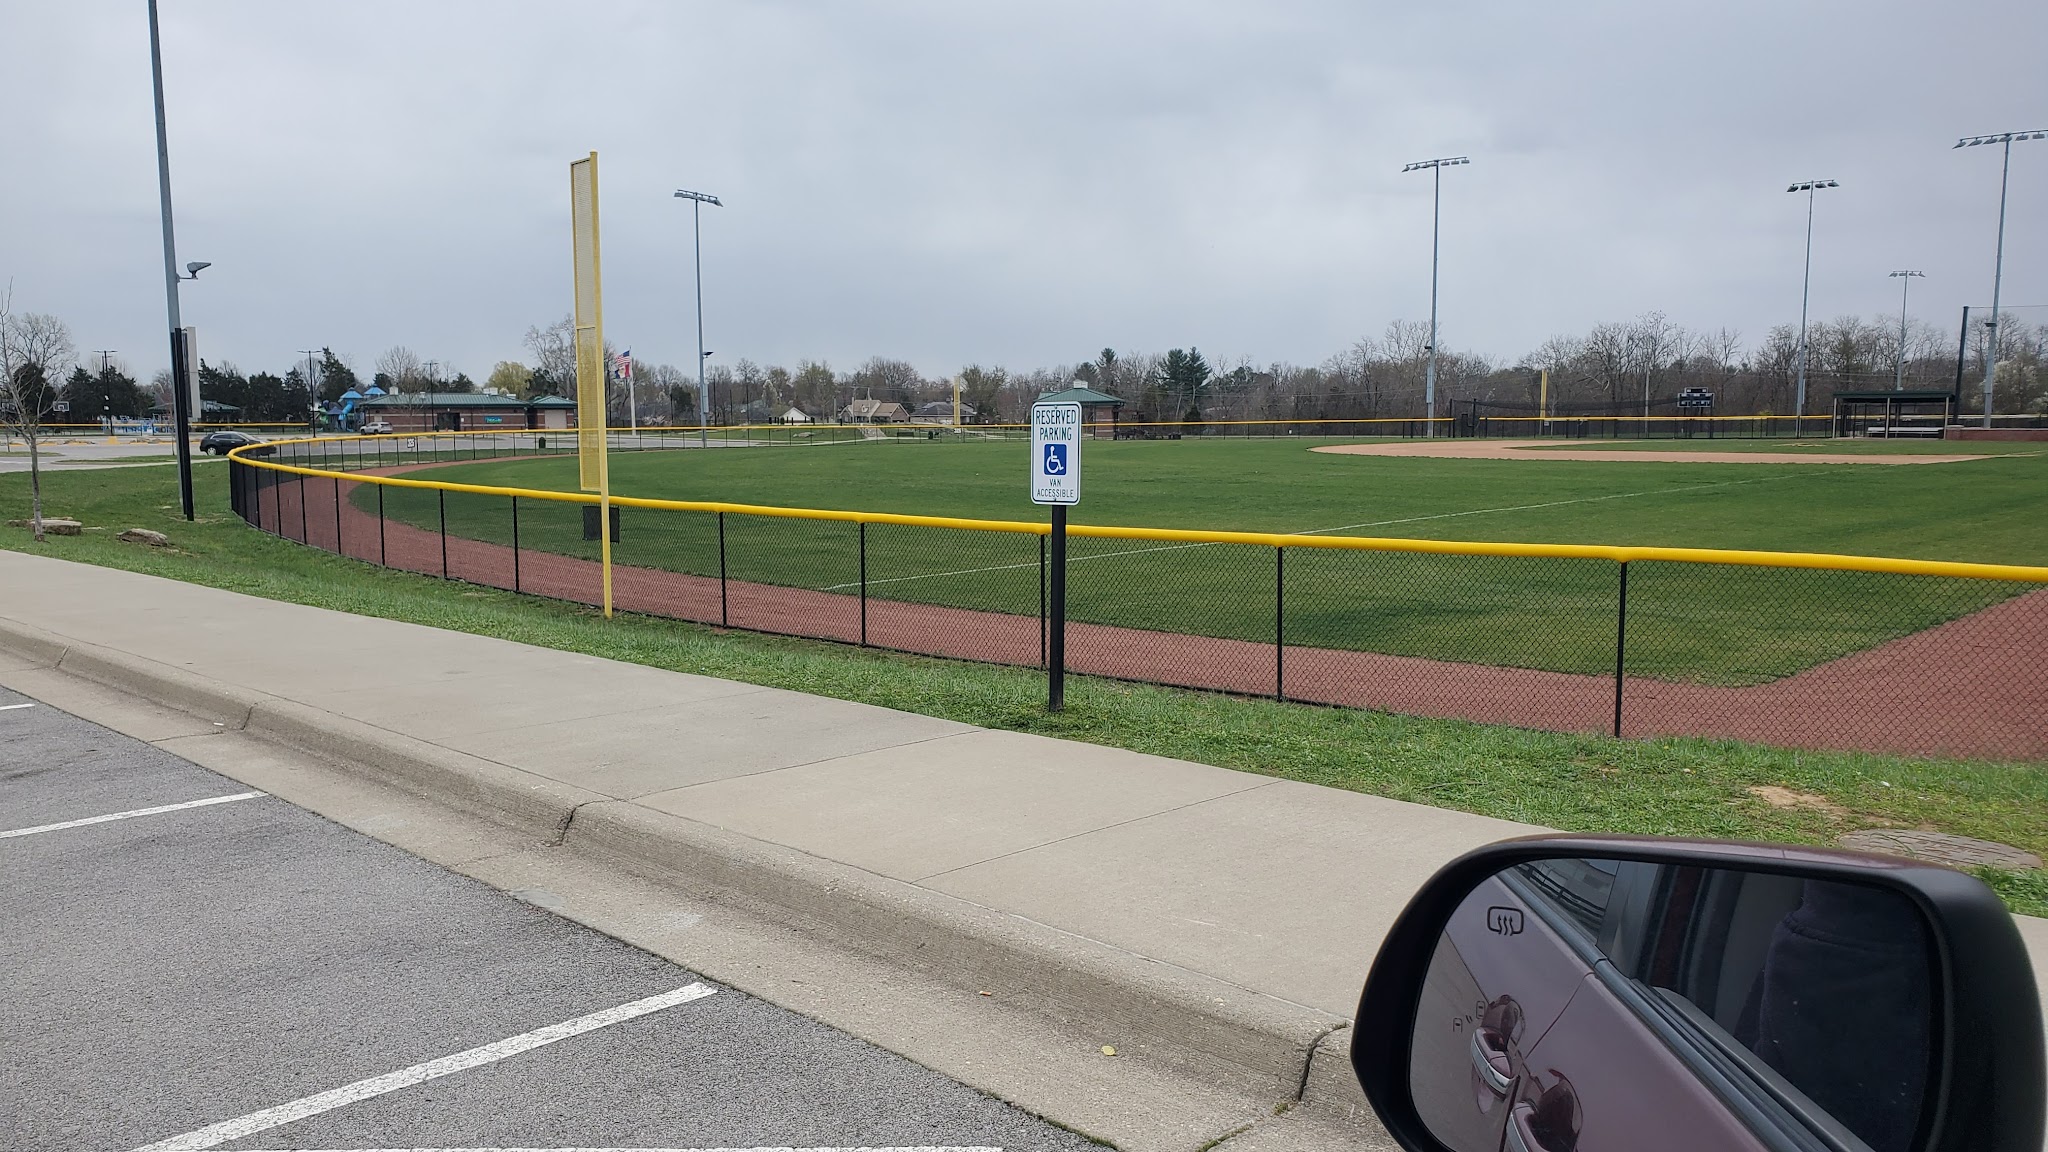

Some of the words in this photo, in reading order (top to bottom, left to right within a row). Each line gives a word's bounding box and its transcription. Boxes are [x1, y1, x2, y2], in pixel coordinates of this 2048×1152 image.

[1035, 409, 1076, 424] RESERVED
[1039, 427, 1072, 440] PARKING
[1049, 479, 1062, 487] VAN
[1037, 489, 1074, 498] ACCESSIBLE
